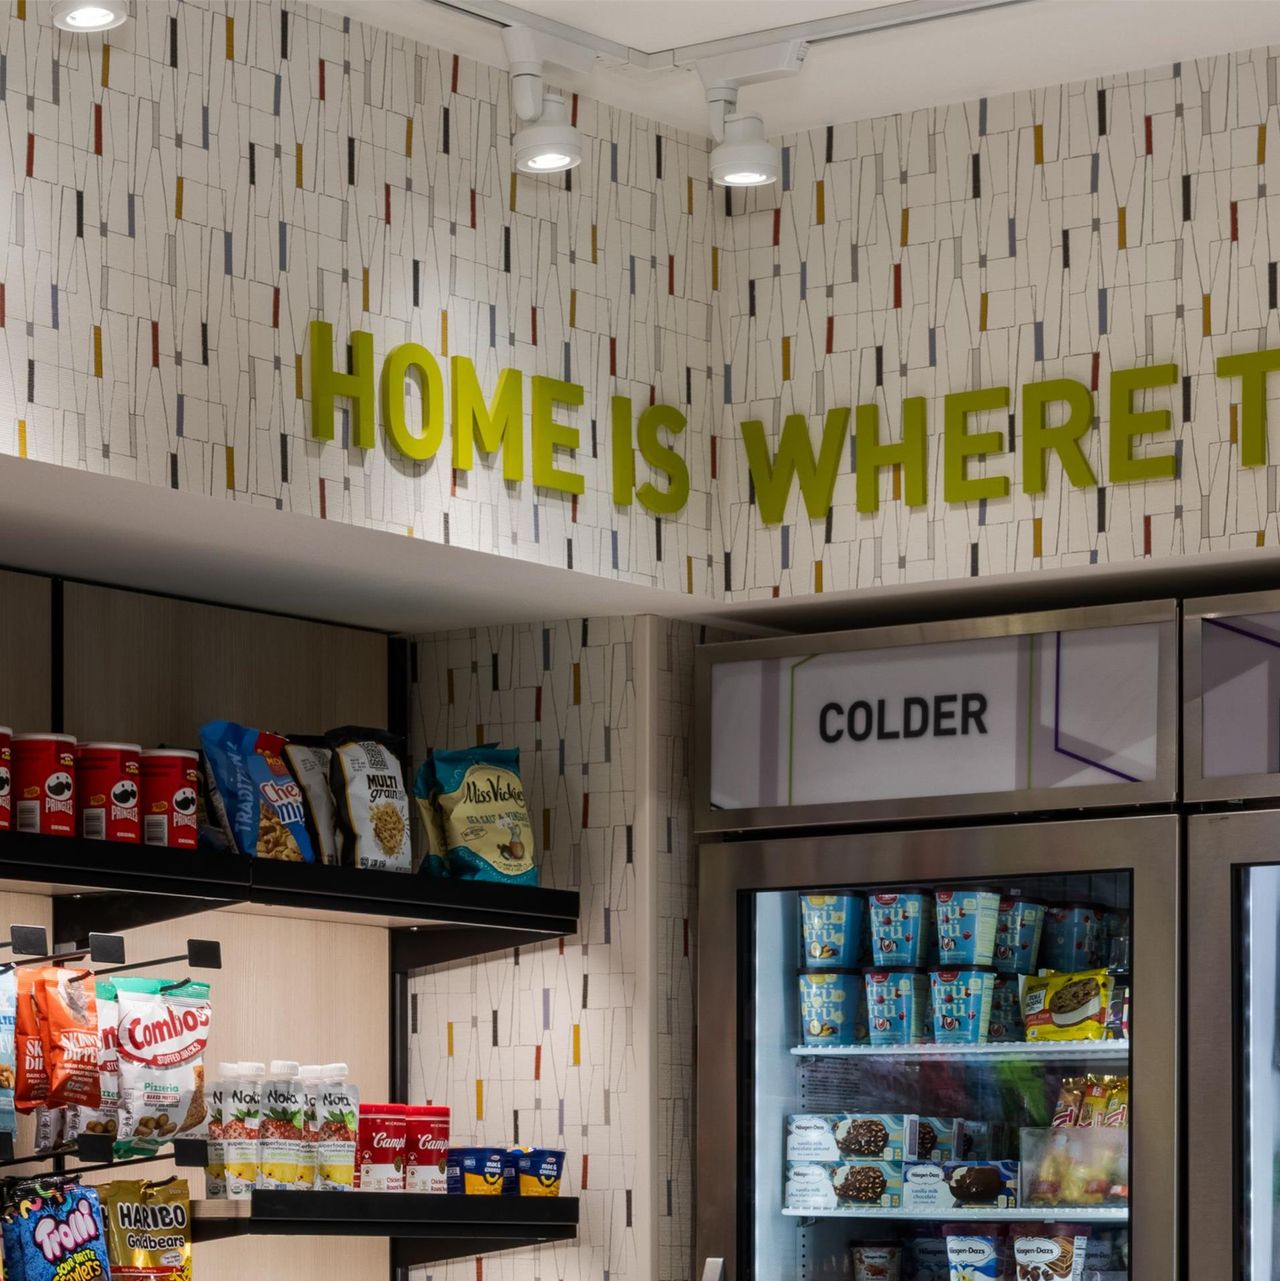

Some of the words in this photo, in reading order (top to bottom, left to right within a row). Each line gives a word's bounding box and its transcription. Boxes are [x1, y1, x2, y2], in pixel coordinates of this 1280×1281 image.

[310, 320, 585, 494] HOME
[611, 396, 690, 514] IS
[740, 363, 1177, 524] WHERE
[819, 693, 988, 743] COLDER
[128, 1006, 209, 1050] Combos
[144, 1082, 179, 1092] Pizzeria
[35, 1197, 98, 1261] Trolli
[119, 1202, 186, 1231] HARIBO
[127, 1234, 185, 1251] Goldbears
